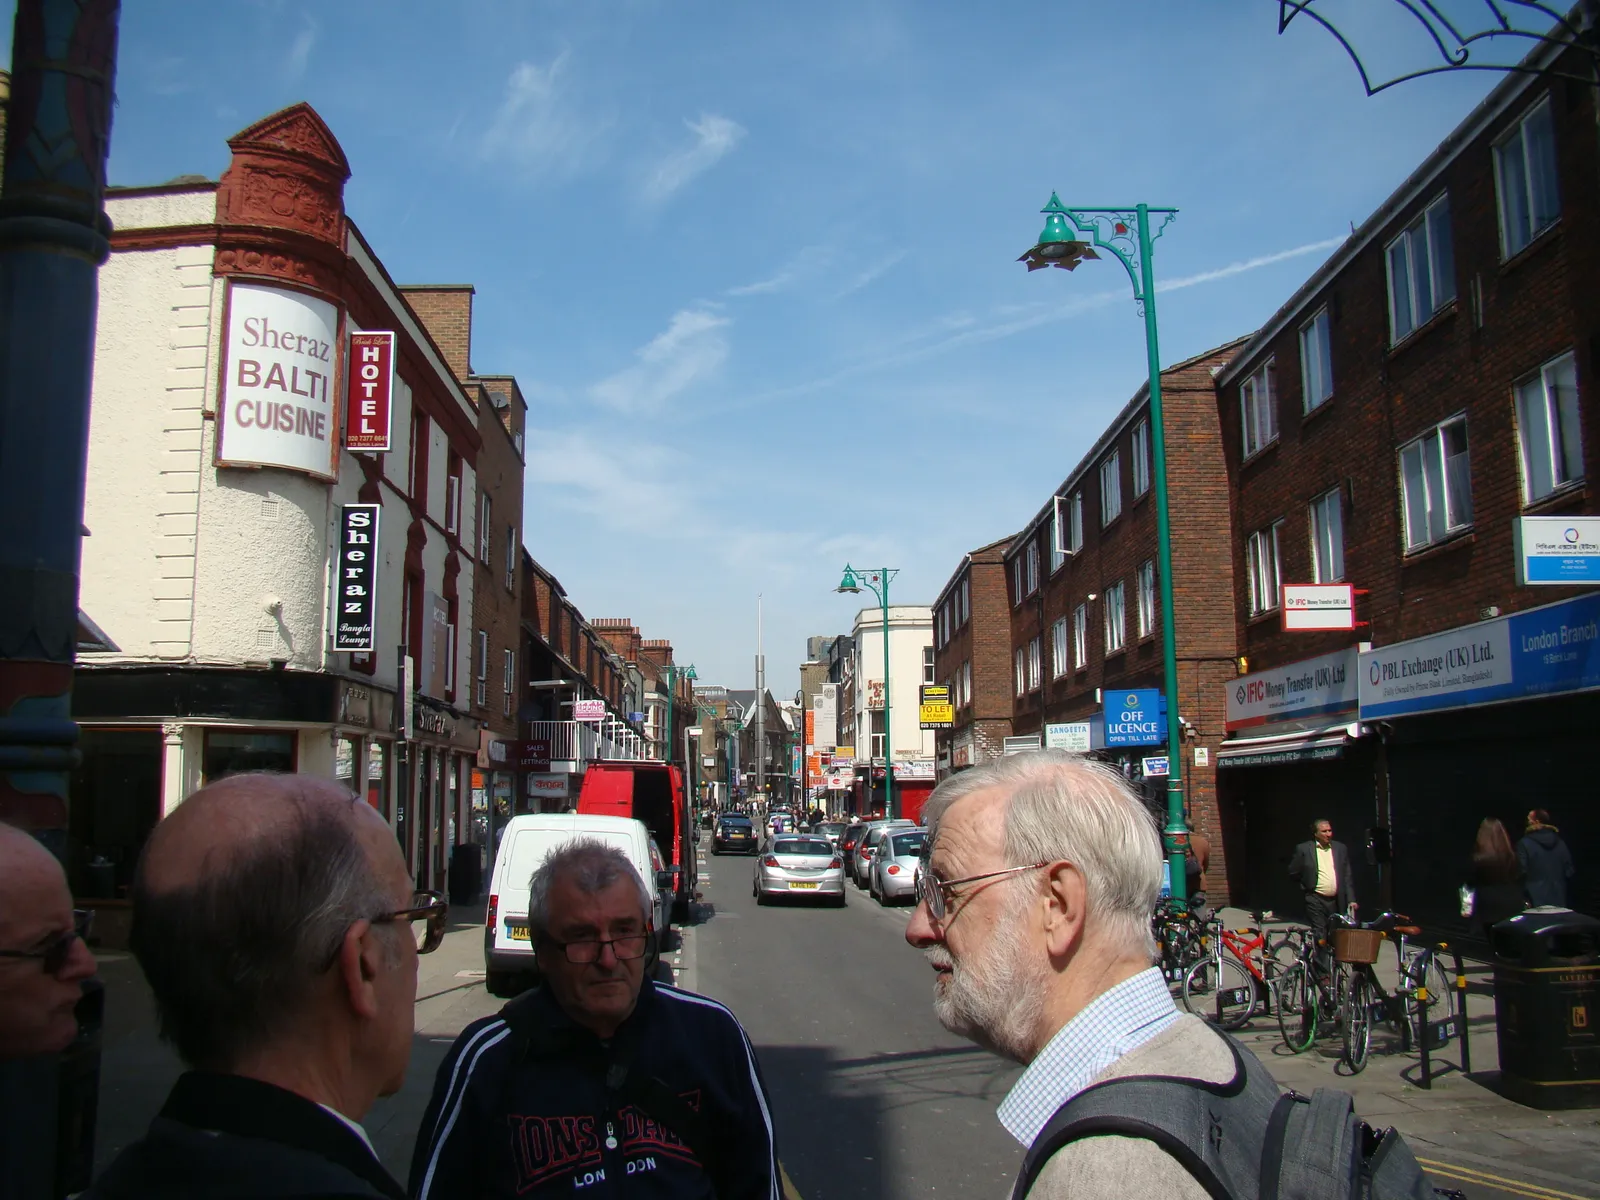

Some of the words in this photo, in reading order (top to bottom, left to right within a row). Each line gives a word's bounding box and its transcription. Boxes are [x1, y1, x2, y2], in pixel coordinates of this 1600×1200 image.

[241, 317, 330, 362] Sheraz
[238, 359, 328, 403] BALTI
[361, 347, 380, 434] HOTEL
[236, 399, 326, 442] CUISINE
[344, 512, 370, 614] Sheraz
[338, 622, 371, 635] Bangla
[338, 634, 370, 646] Lounge
[1522, 628, 1558, 652] London
[1560, 618, 1598, 645] Branch
[1382, 662, 1399, 681] PBL
[1402, 656, 1443, 676] Exchange
[1445, 646, 1470, 672] (UK)
[1472, 640, 1494, 664] Ltd.
[868, 680, 884, 690] Swee
[1247, 680, 1264, 703] IFIC
[1265, 681, 1285, 698] Money
[1286, 673, 1313, 693] Transfer
[1315, 667, 1330, 690] (UK)
[1332, 664, 1345, 684] Ltd
[1049, 726, 1087, 734] SANGEETA
[1108, 722, 1157, 734] LICENCE
[1121, 711, 1144, 722] OFF
